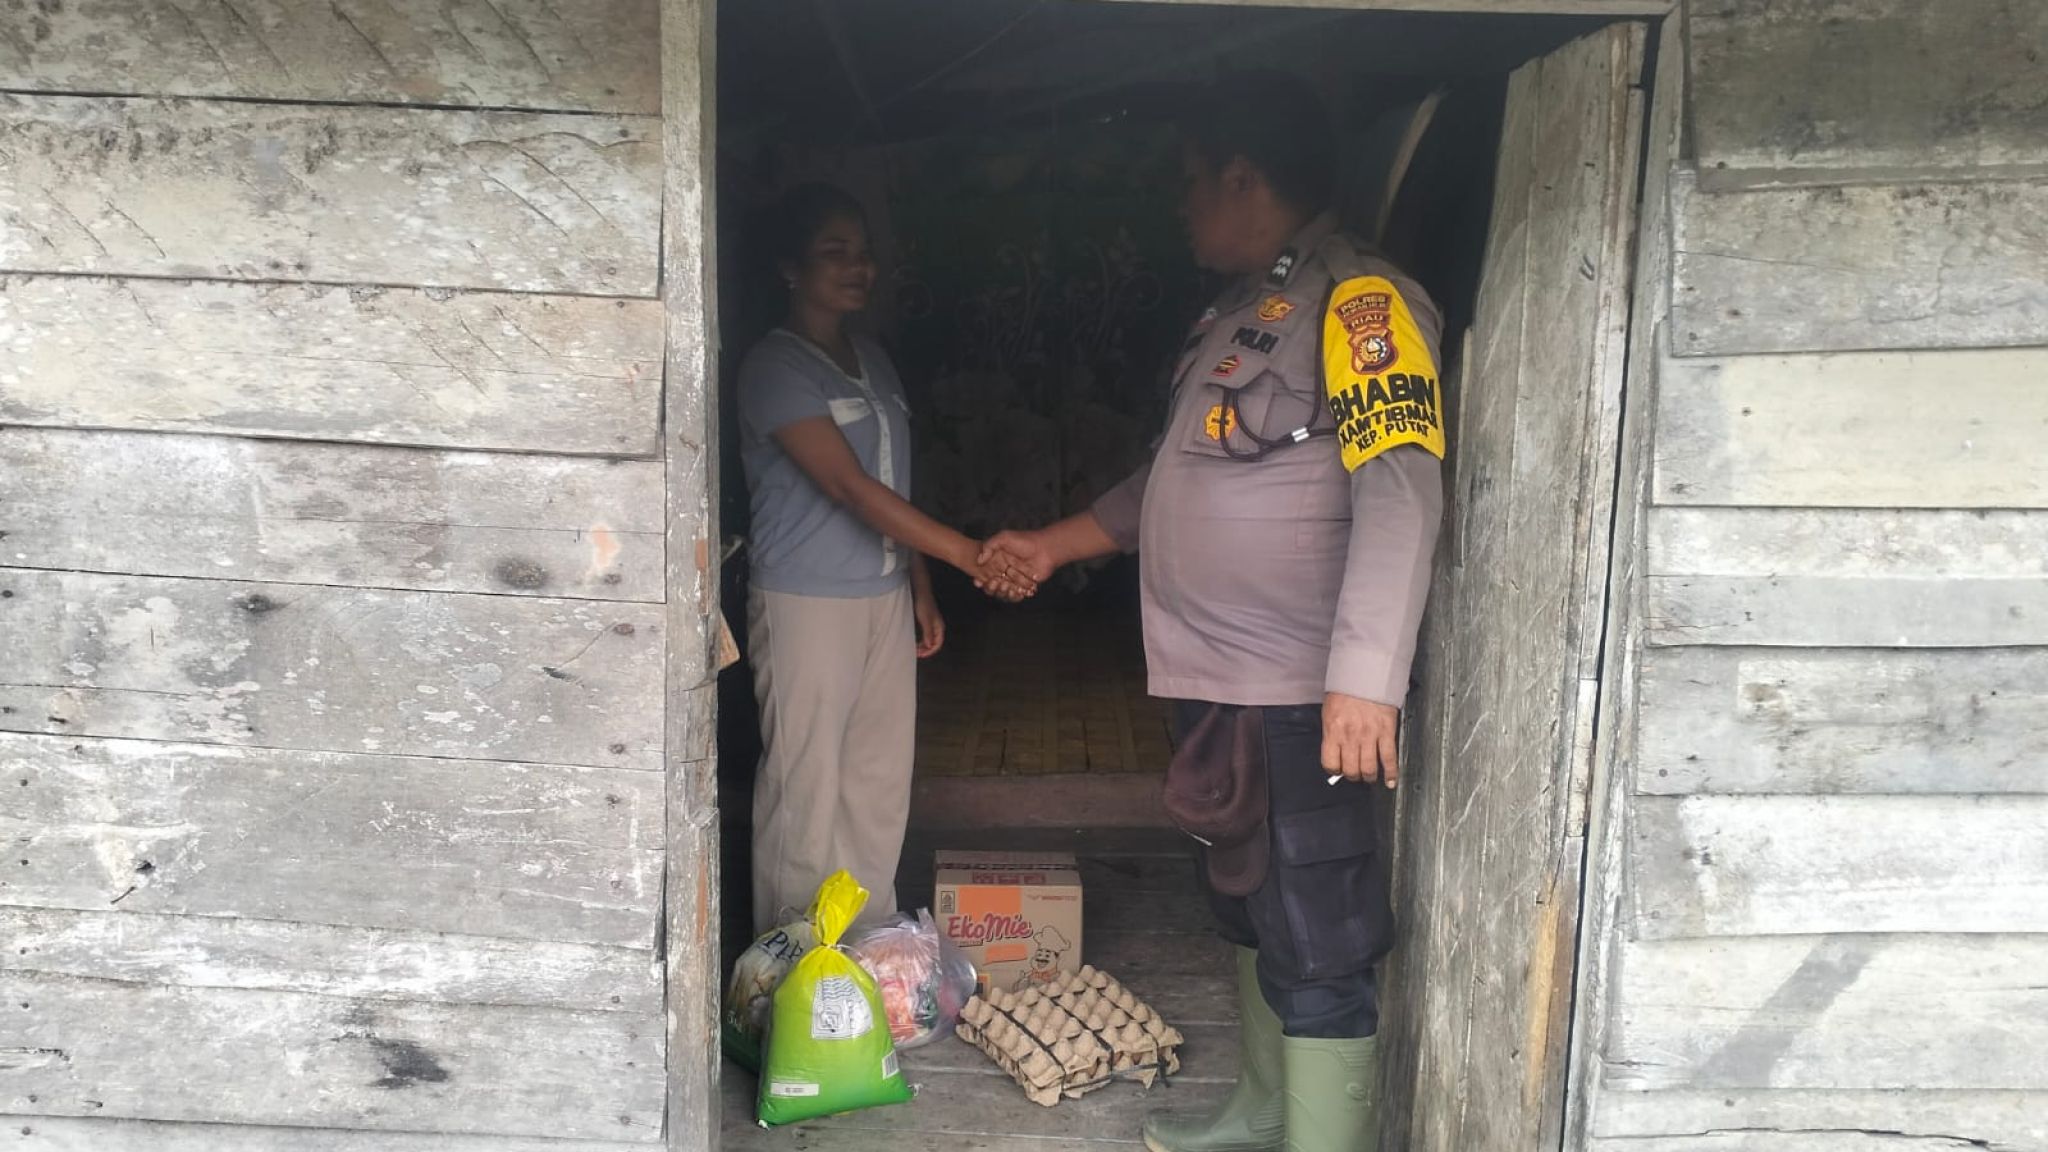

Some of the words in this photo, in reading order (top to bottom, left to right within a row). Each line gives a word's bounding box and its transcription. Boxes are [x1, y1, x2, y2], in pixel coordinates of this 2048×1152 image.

[1341, 295, 1386, 313] POLRES
[1351, 314, 1384, 329] RIAU
[1230, 327, 1279, 354] POLRI
[1329, 373, 1435, 427] BHABIN
[1356, 430, 1382, 453] KEP.
[1385, 420, 1430, 438] PUTAT
